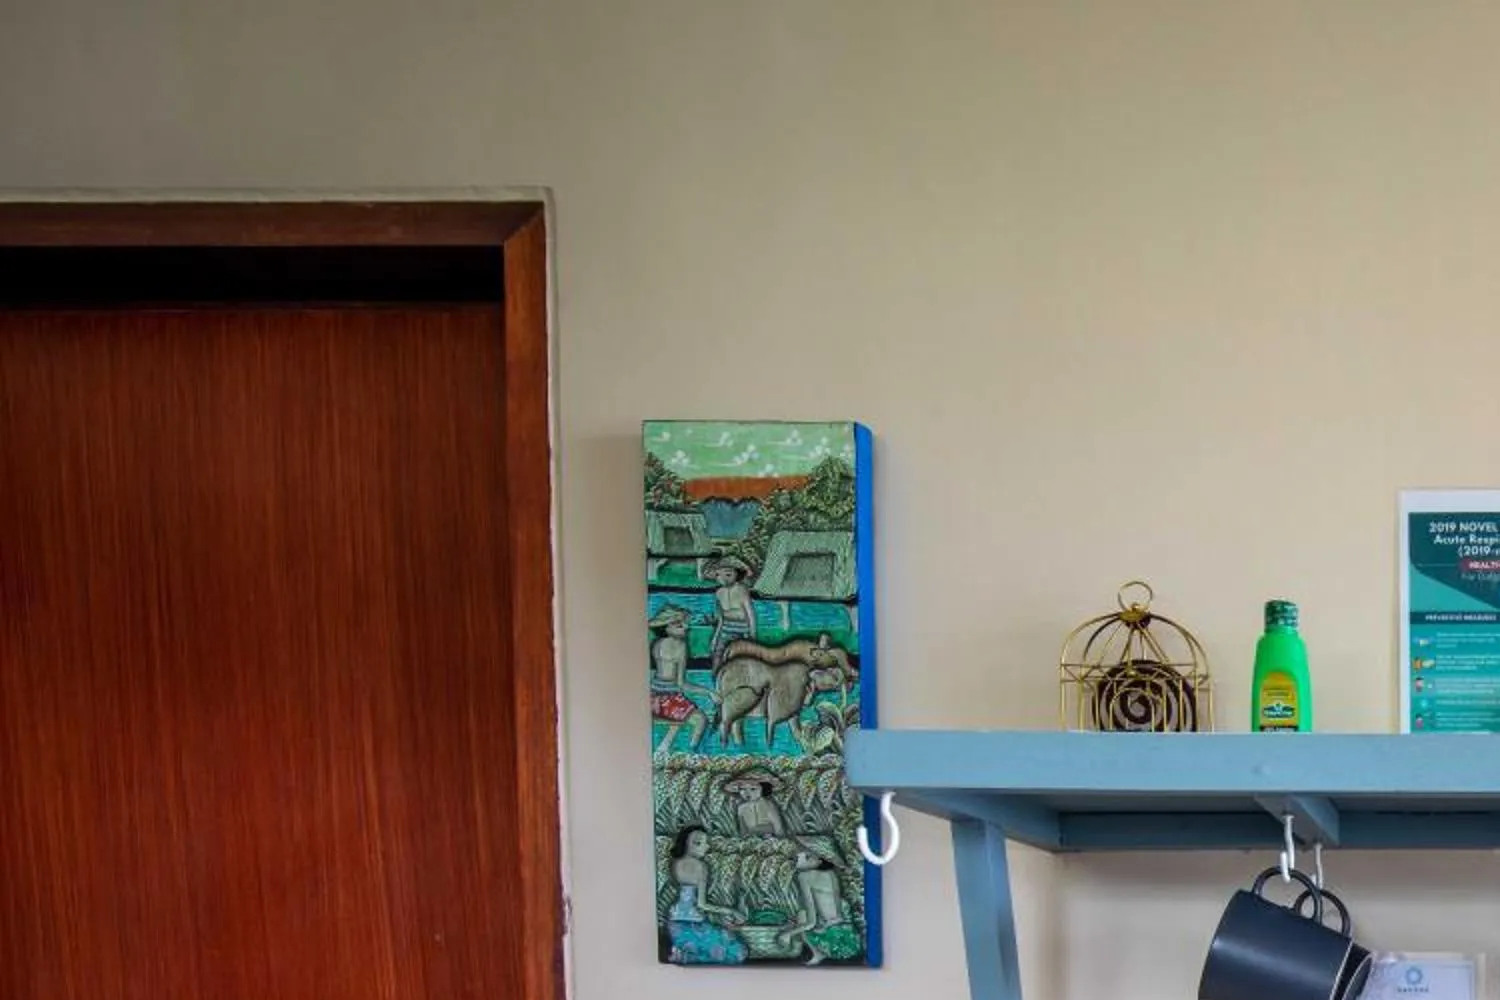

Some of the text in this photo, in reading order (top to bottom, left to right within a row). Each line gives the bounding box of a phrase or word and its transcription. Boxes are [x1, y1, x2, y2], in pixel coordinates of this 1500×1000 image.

[1429, 521, 1456, 533] 2019
[1459, 521, 1498, 533] NOVEL
[1433, 535, 1465, 544] Acute
